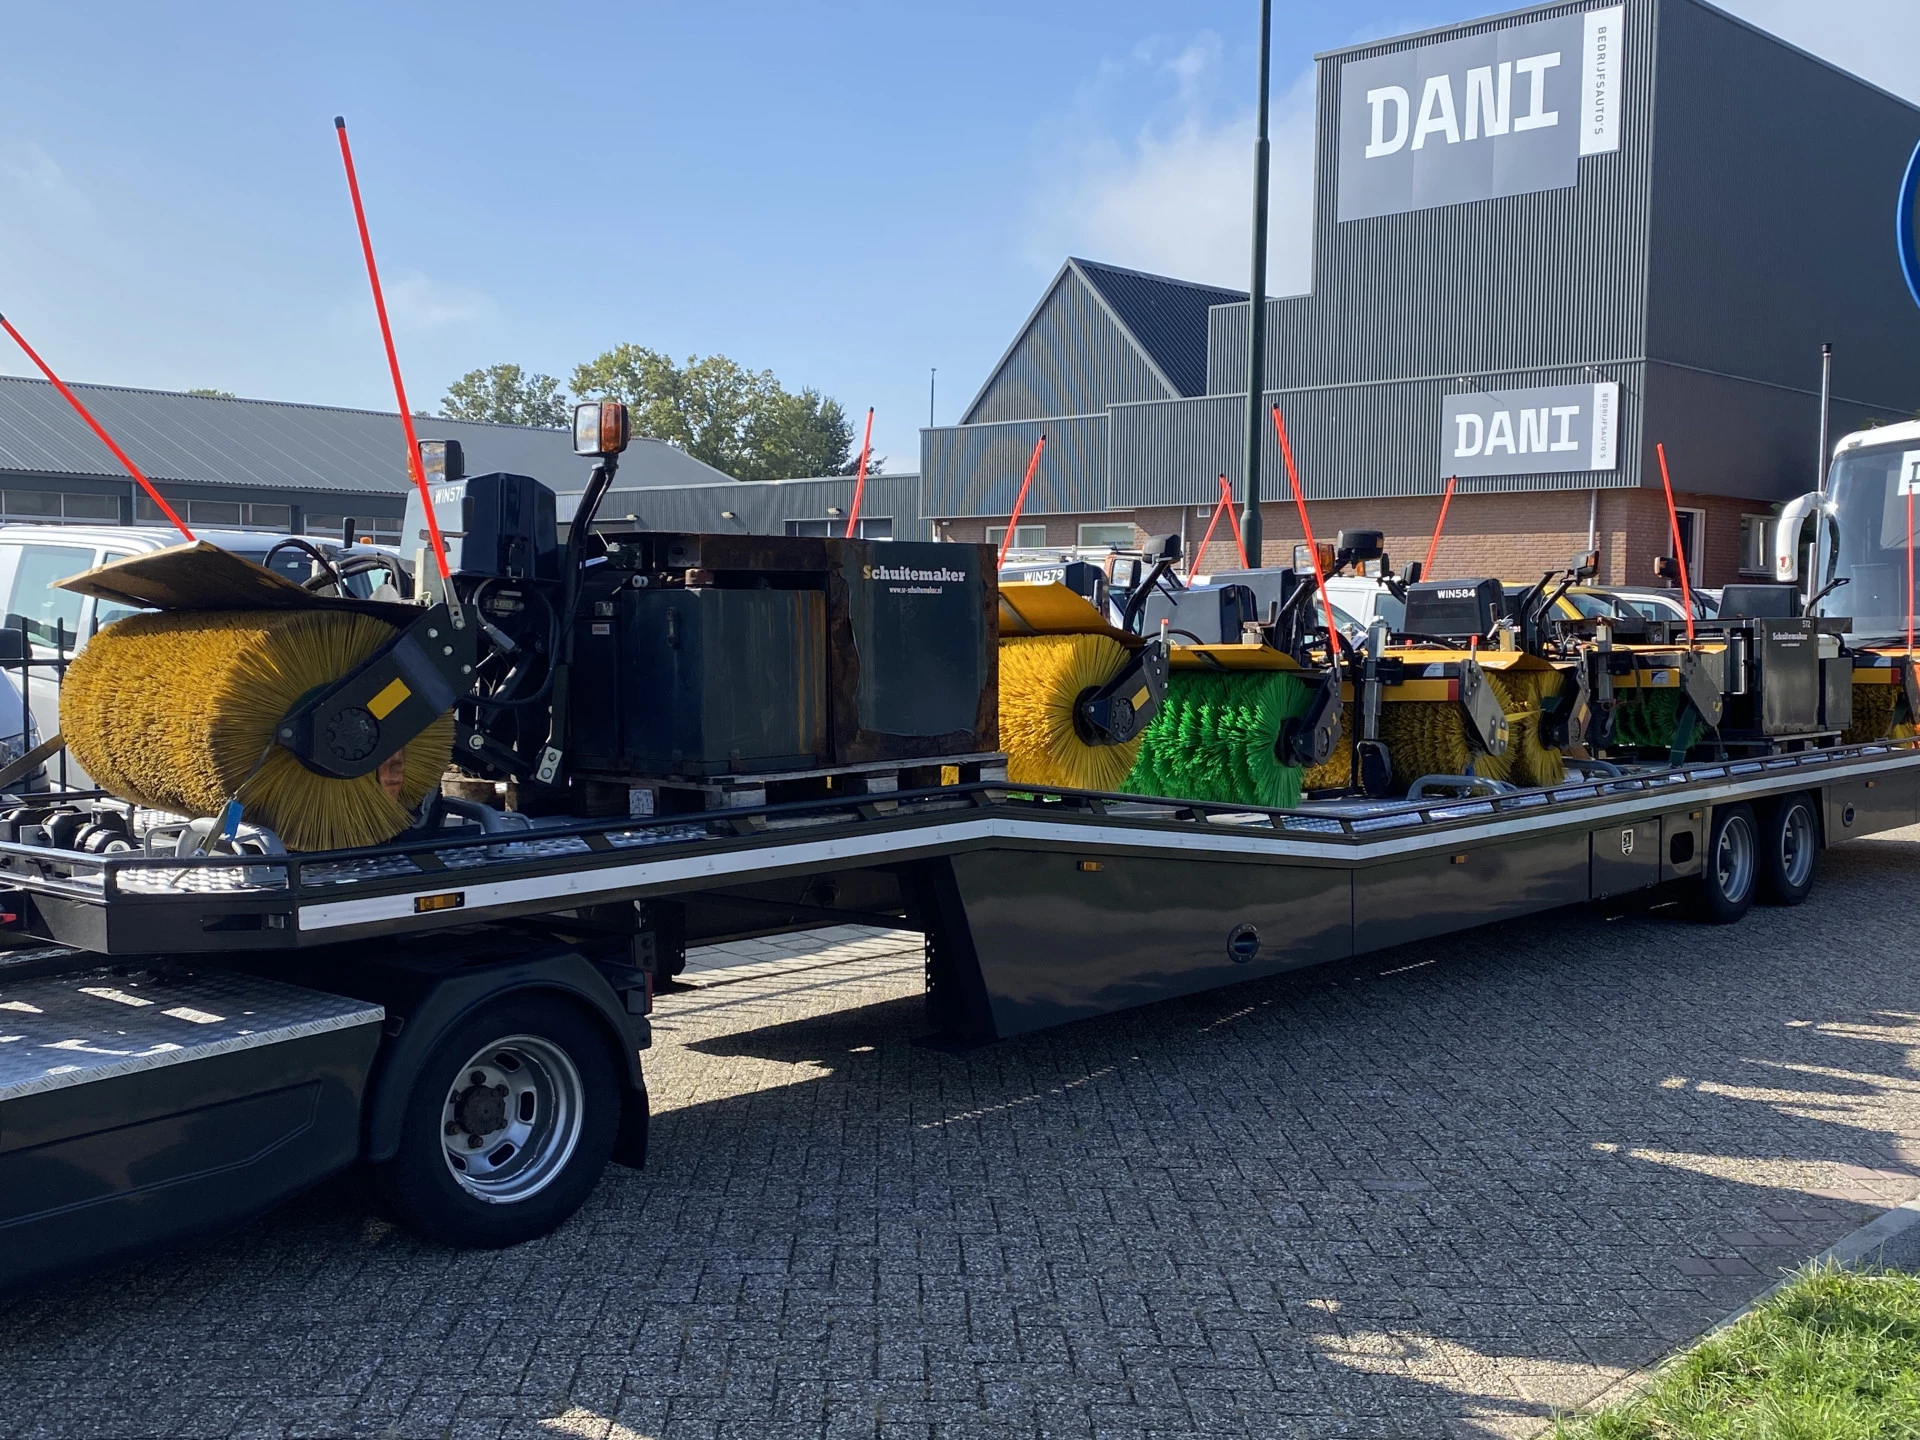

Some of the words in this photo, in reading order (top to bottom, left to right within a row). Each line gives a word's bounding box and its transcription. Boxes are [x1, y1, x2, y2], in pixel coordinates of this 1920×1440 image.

[1594, 26, 1607, 135] BEDRIJFSAUTO'S
[1365, 51, 1561, 159] DANI
[1454, 405, 1580, 458] DANI
[863, 564, 966, 582] Schuitemaker
[1023, 568, 1065, 582] WIN579
[1437, 588, 1476, 599] WIN584
